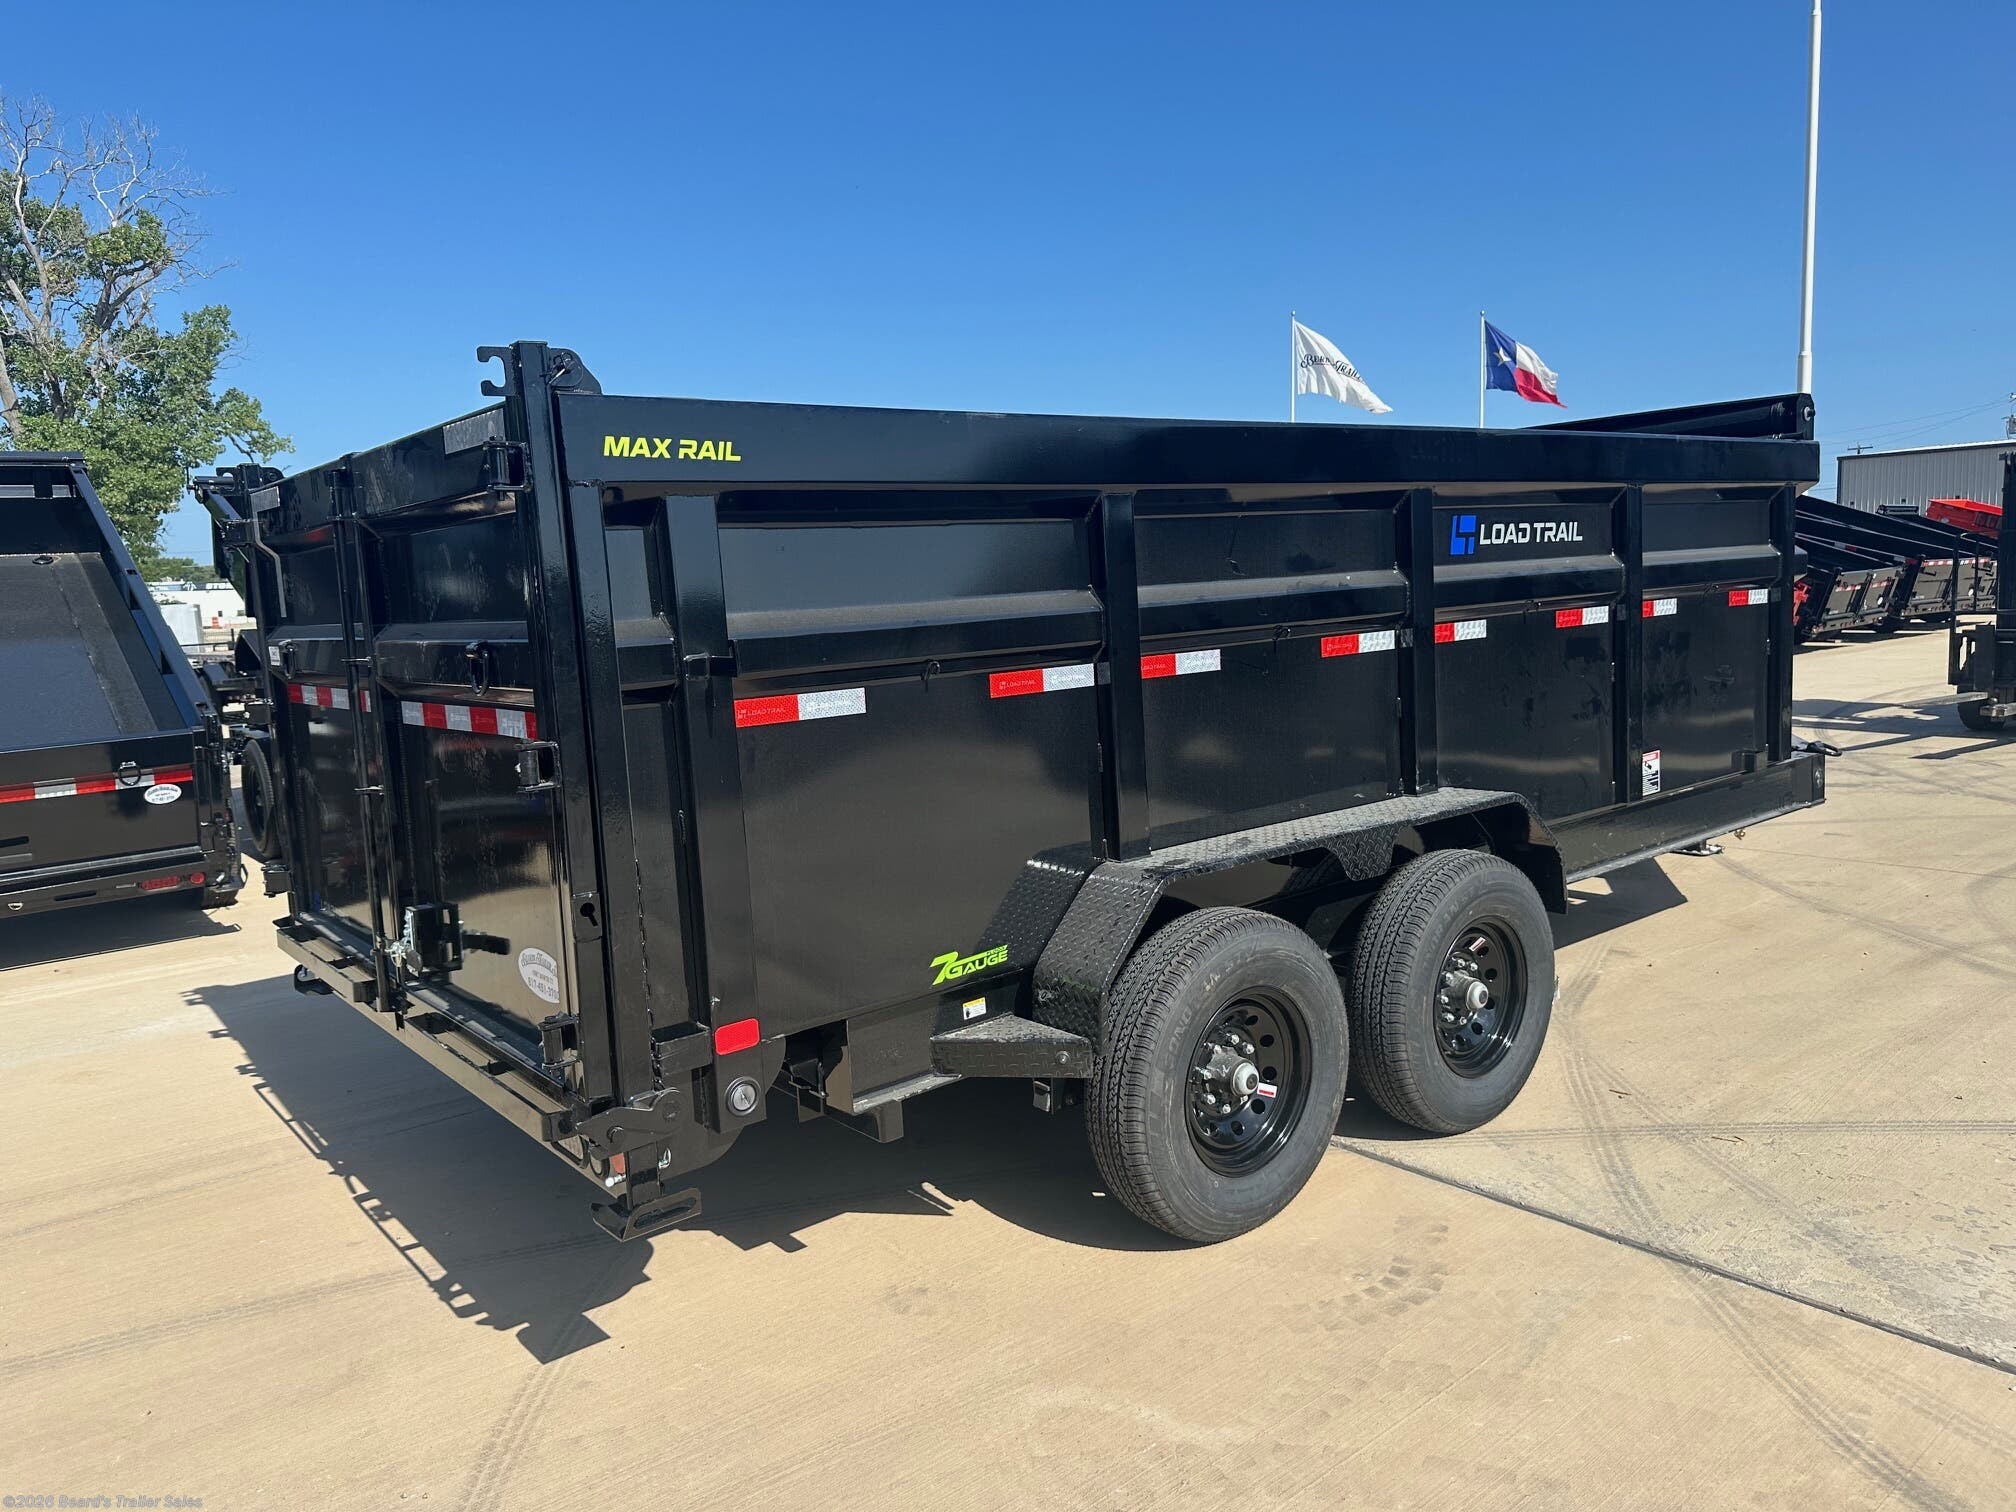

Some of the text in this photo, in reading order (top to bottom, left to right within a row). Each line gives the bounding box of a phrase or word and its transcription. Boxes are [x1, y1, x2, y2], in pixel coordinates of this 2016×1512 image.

[603, 435, 741, 461] MAX RAIL
[945, 949, 1009, 980] GAUGE
